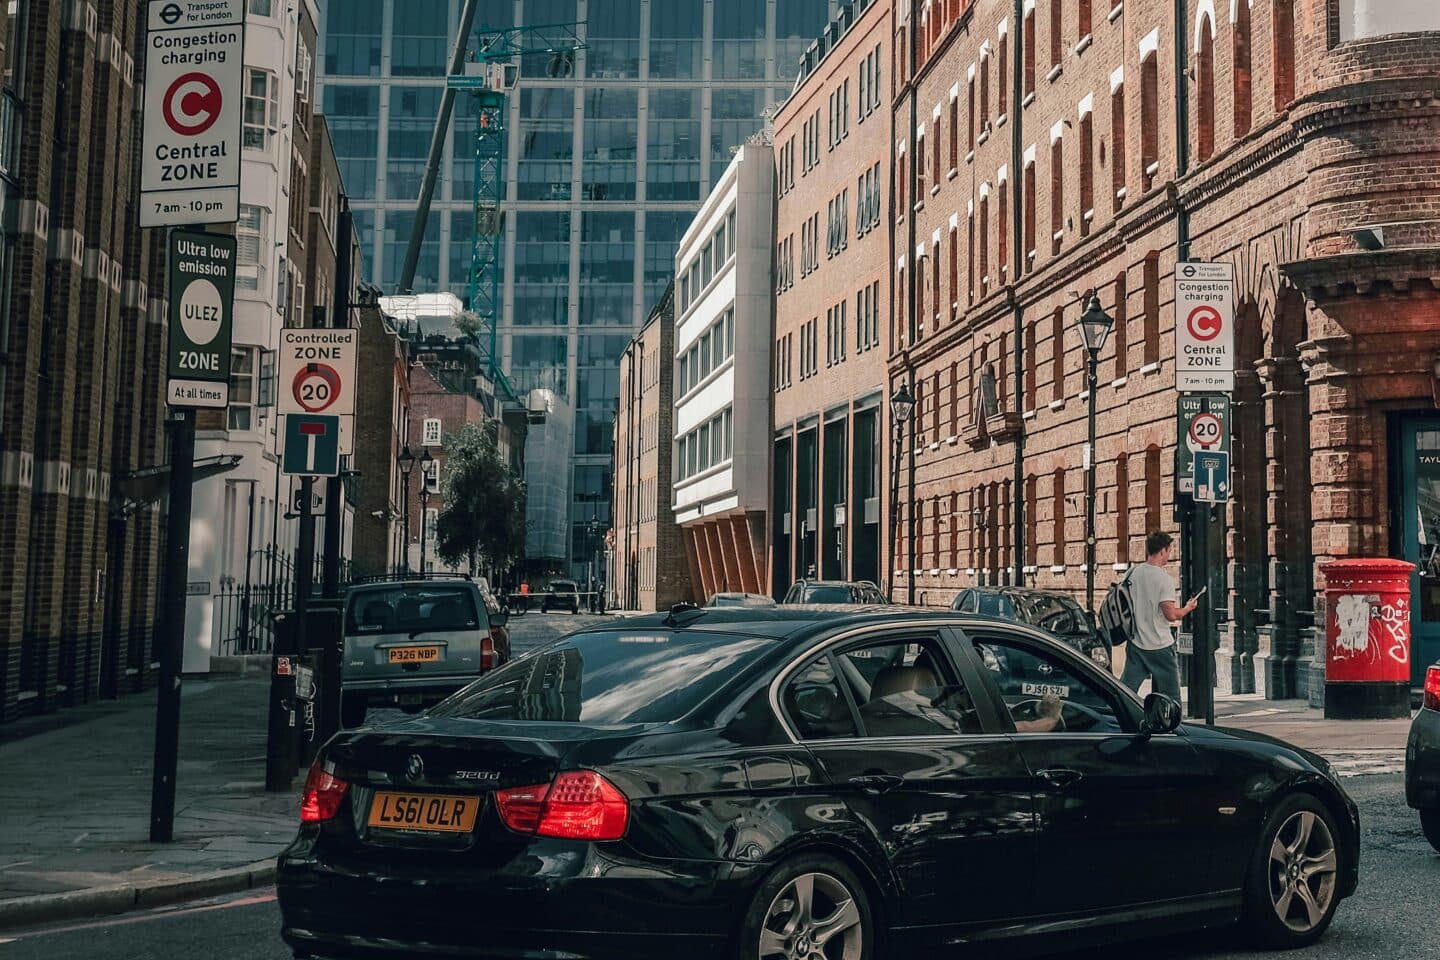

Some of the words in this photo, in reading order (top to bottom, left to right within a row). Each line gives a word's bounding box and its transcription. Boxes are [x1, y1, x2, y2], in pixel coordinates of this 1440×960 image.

[187, 0, 228, 11] Transport
[187, 11, 198, 22] for
[200, 9, 233, 21] London
[153, 32, 237, 50] Congestion
[161, 48, 227, 65] charging
[155, 141, 227, 161] Central
[161, 163, 218, 181] ZONE
[177, 240, 208, 258] Ultra
[211, 243, 230, 260] low
[179, 259, 227, 276] emission
[1179, 283, 1229, 292] Congestion
[1185, 293, 1223, 301] charging
[184, 304, 218, 321] ULEZ
[285, 333, 352, 344] Controlled
[295, 347, 341, 360] ZONE
[1184, 344, 1226, 356] Central
[179, 351, 219, 370] ZONE
[1188, 356, 1221, 366] ZONE
[175, 387, 184, 398] At
[187, 387, 197, 398] all
[200, 388, 222, 400] times
[302, 384, 328, 401] 20
[1183, 401, 1201, 410] Ultr
[1208, 401, 1225, 410] low
[1196, 423, 1217, 436] 20
[390, 650, 416, 660] P326
[418, 649, 437, 659] NBP
[456, 771, 501, 780] 320d
[380, 795, 424, 823] LS61
[426, 799, 466, 826] OLR
